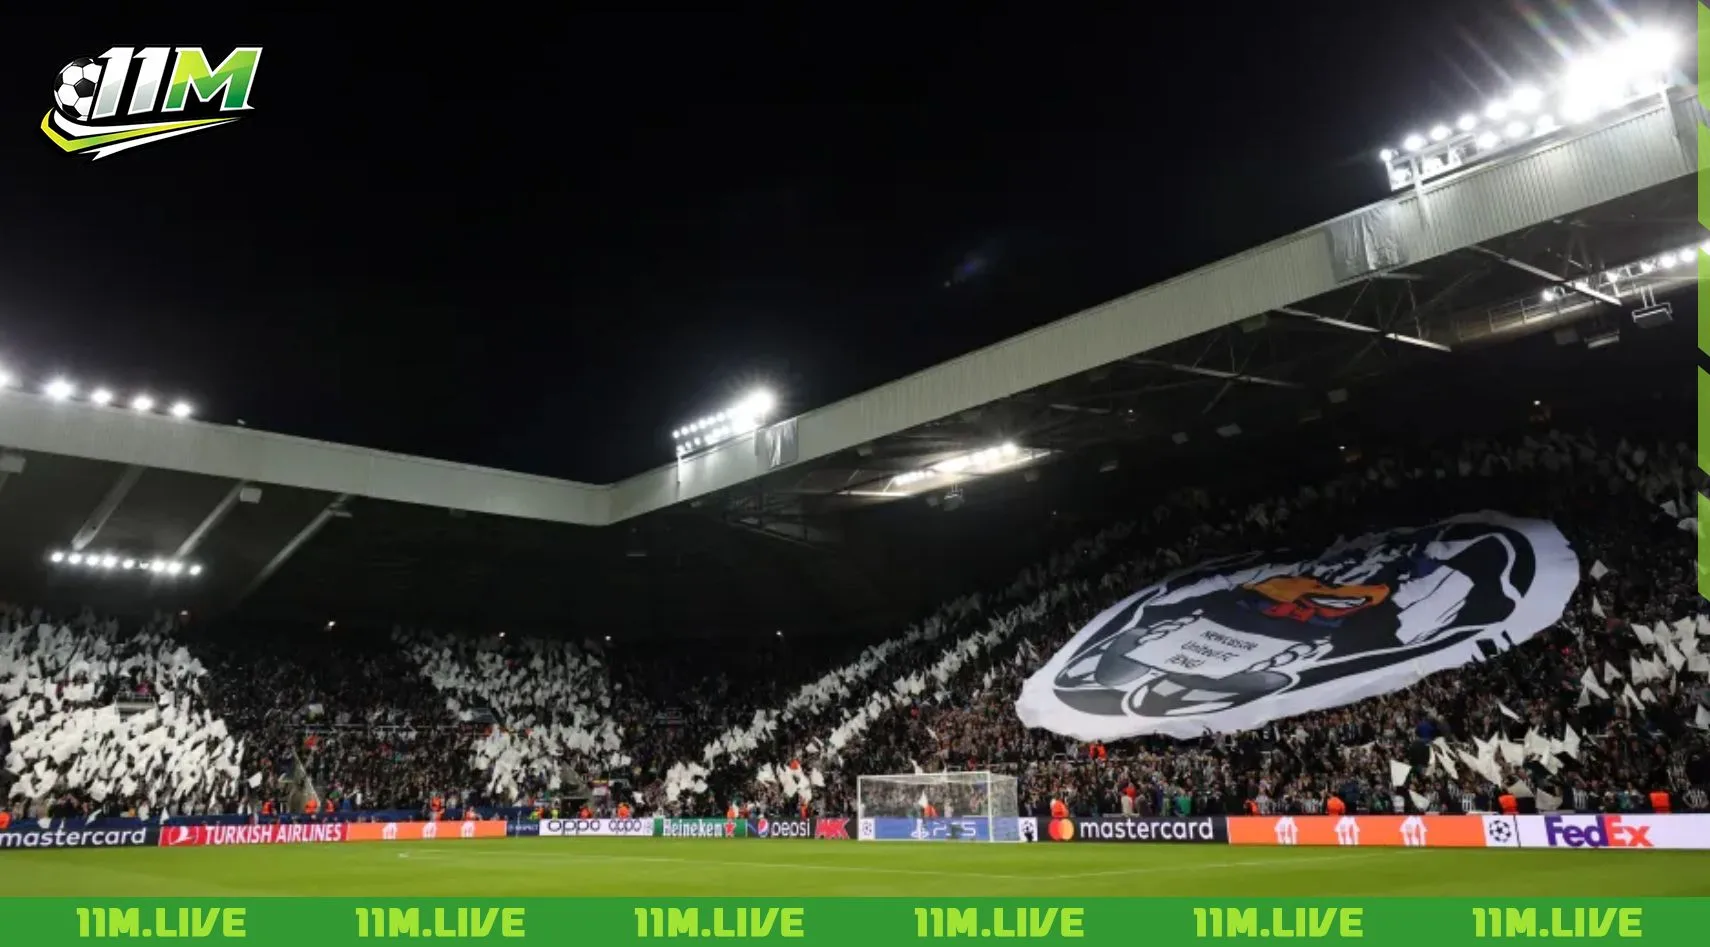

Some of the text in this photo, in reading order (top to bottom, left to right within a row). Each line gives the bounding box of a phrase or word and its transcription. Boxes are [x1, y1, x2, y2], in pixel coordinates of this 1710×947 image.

[0, 827, 146, 847] mastercard
[276, 823, 342, 843] AIRLINES
[547, 820, 600, 834] oppo
[663, 819, 723, 837] Heineken
[771, 818, 811, 837] pepsi
[1080, 817, 1214, 839] mastercard
[1544, 815, 1653, 847] FedEx
